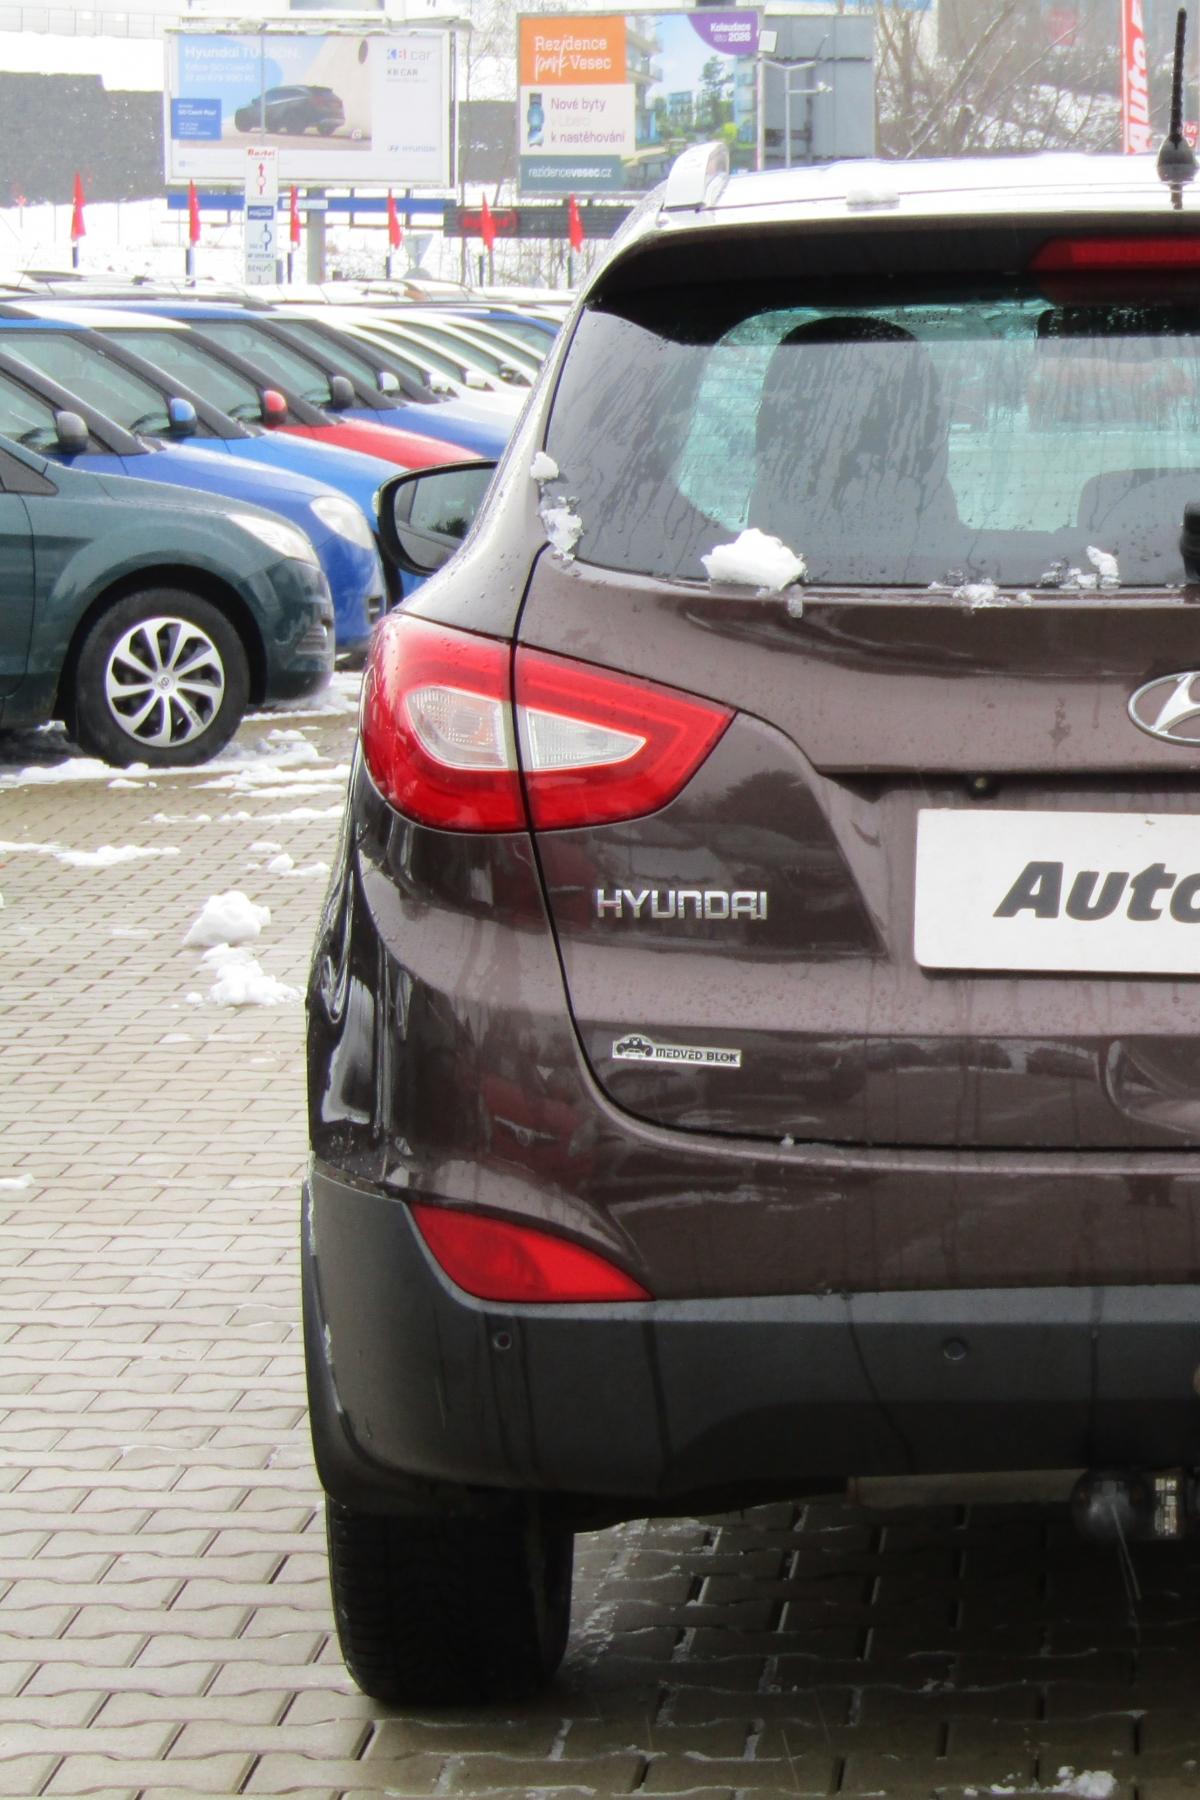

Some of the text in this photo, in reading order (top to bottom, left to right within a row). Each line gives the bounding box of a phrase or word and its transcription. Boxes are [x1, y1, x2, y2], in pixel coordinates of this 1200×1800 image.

[534, 34, 608, 53] Rezidence
[570, 54, 612, 71] Vesec
[551, 97, 606, 113] Nové byty
[550, 131, 625, 144] k nastěhování
[597, 888, 768, 920] HYUNDAI
[706, 1051, 738, 1063] BLOK
